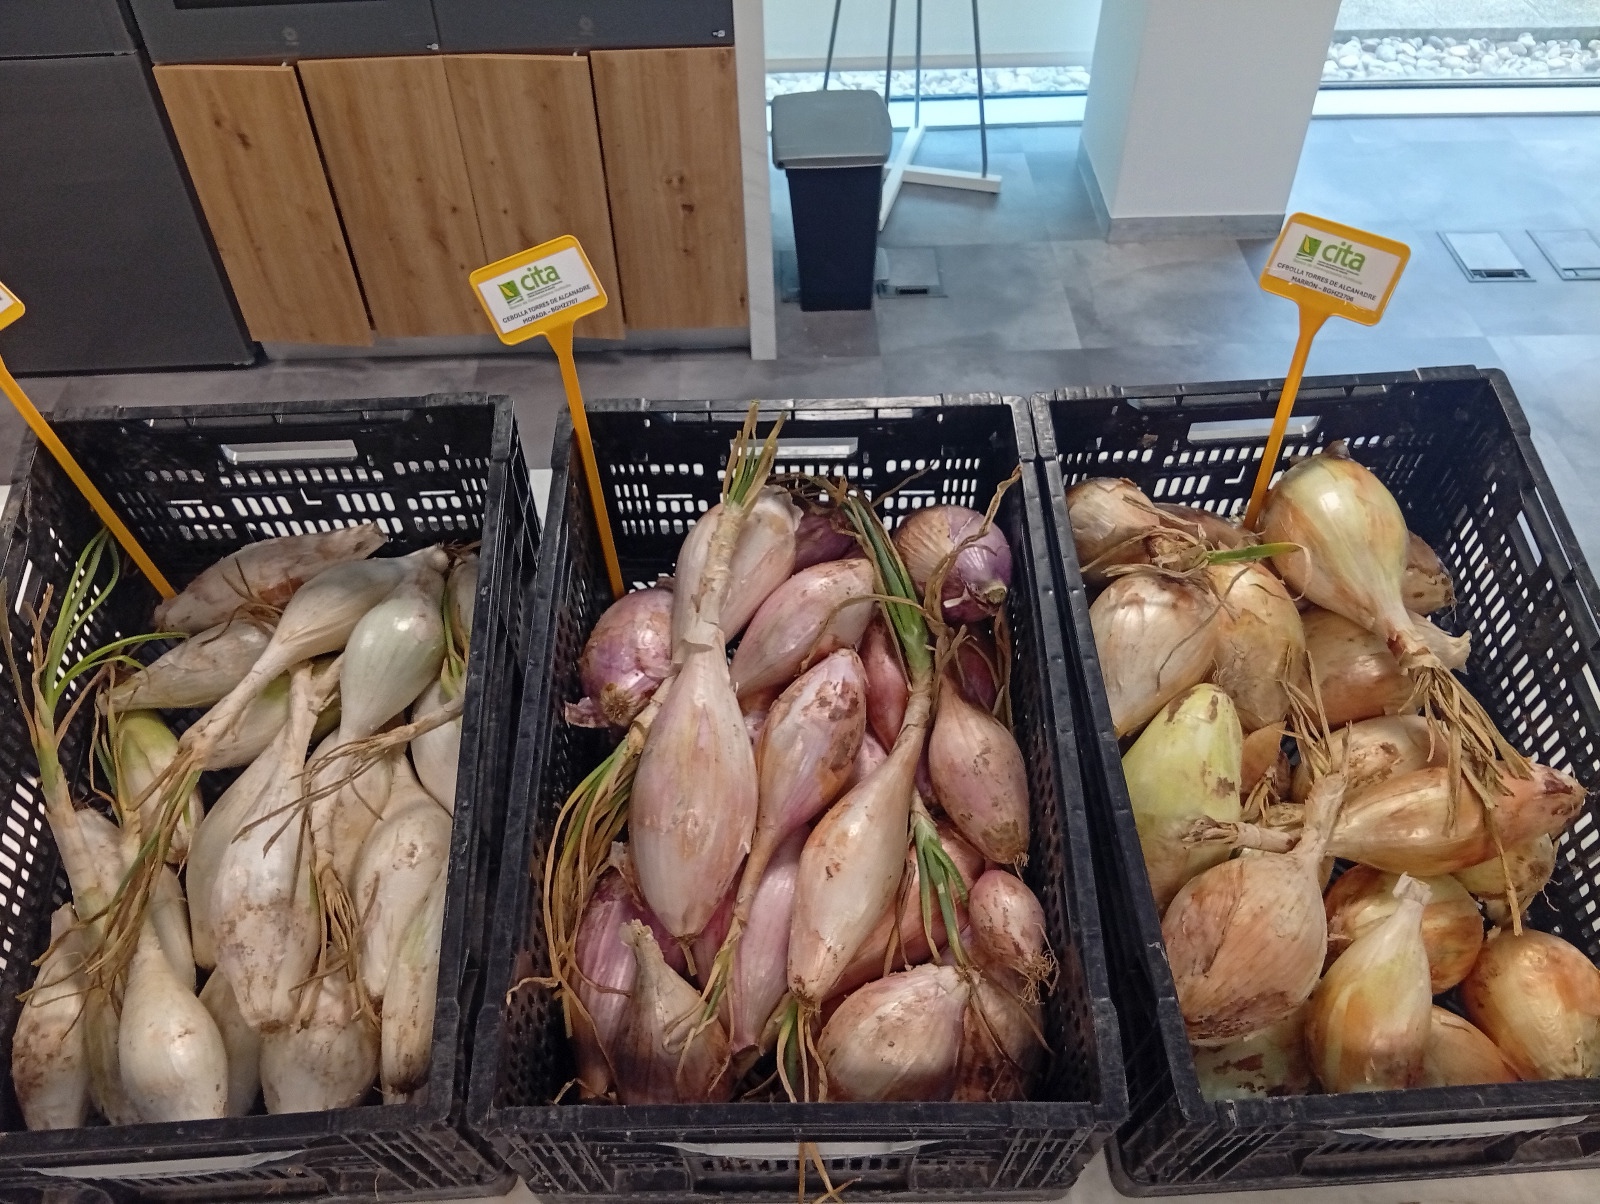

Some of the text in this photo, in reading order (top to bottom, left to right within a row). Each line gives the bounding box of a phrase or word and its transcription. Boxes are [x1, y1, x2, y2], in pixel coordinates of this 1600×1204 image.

[1322, 241, 1366, 272] cita
[521, 265, 560, 291] cita
[1277, 262, 1304, 276] CEBOLLA
[1305, 271, 1329, 284] TORRES
[1329, 279, 1338, 288] DE
[1338, 283, 1377, 301] ALCANADRE
[1291, 275, 1318, 290] MARRÓN
[502, 309, 529, 323] CEBOLLA
[528, 301, 550, 313] TORRES
[558, 284, 591, 301] ALCANADRE
[522, 311, 548, 324] MORADA
